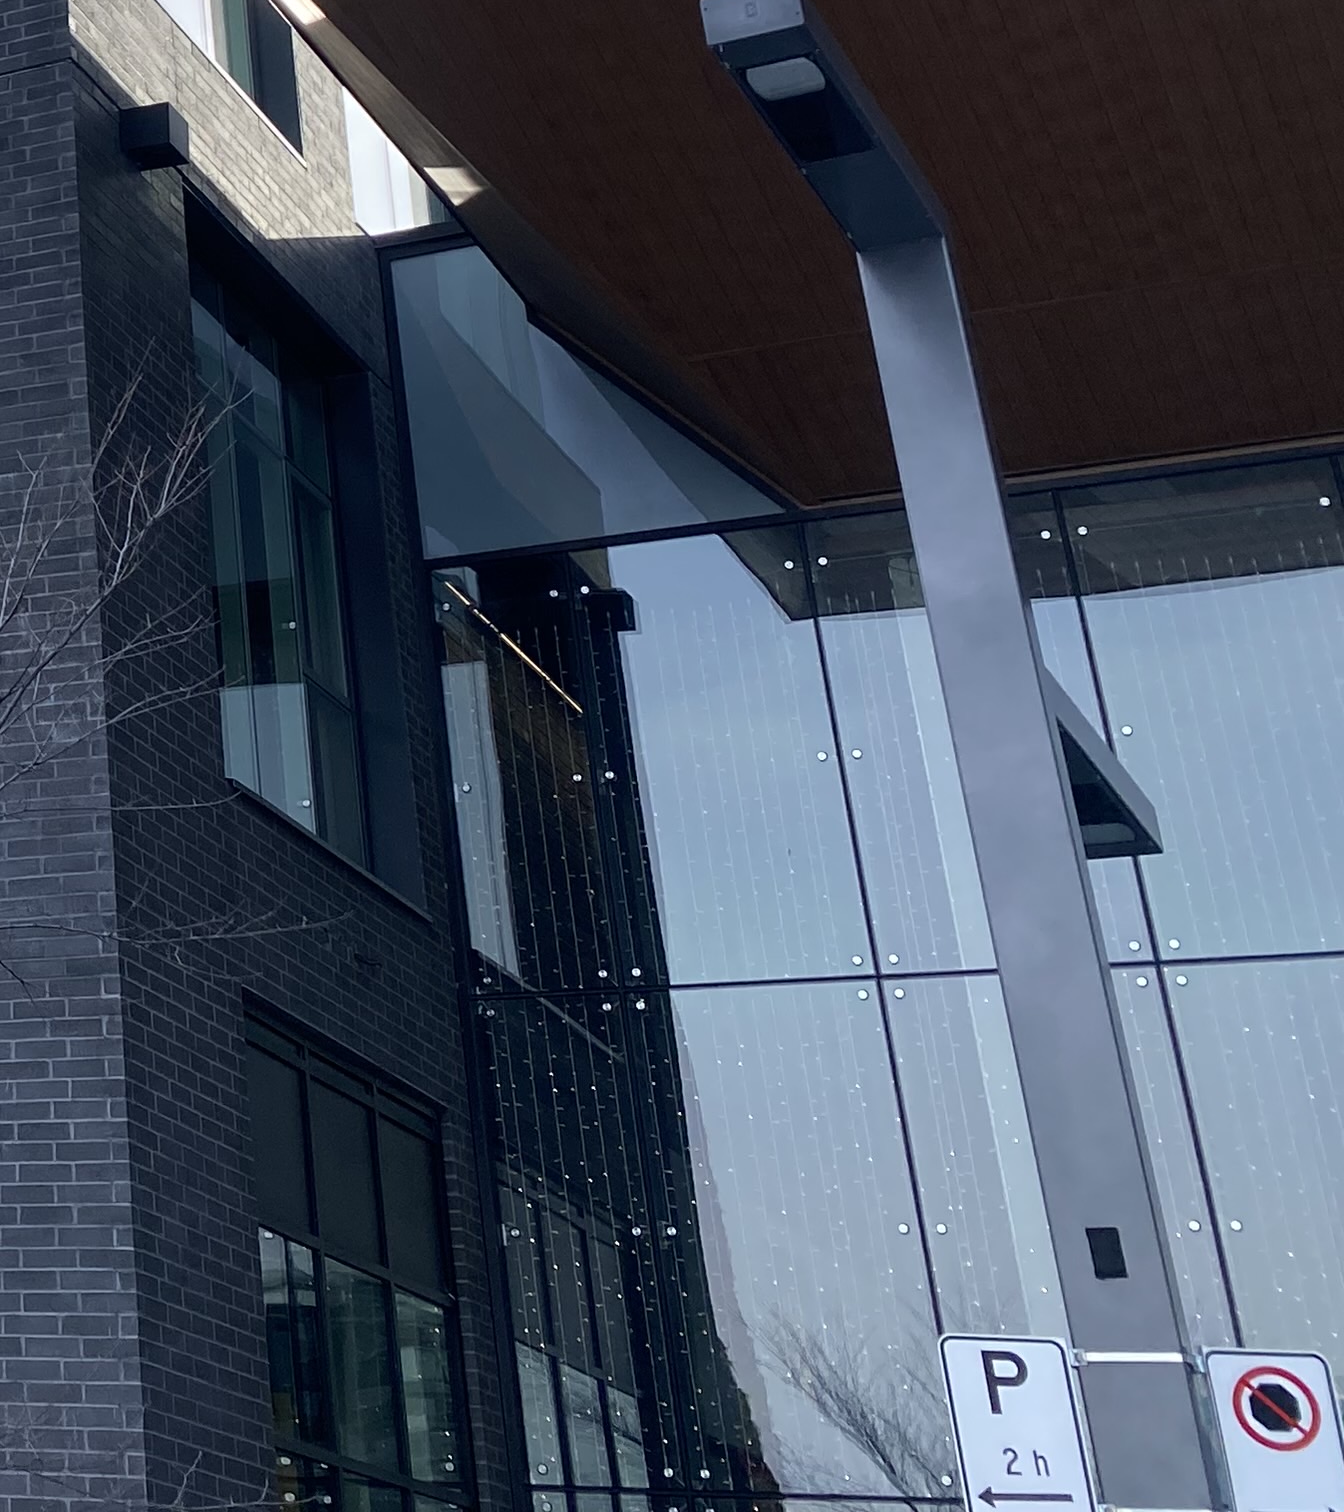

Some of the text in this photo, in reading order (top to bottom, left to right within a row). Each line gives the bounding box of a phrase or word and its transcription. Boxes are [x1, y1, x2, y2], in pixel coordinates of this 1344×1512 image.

[981, 1350, 1028, 1414] P
[1003, 1447, 1050, 1477] 2 h
